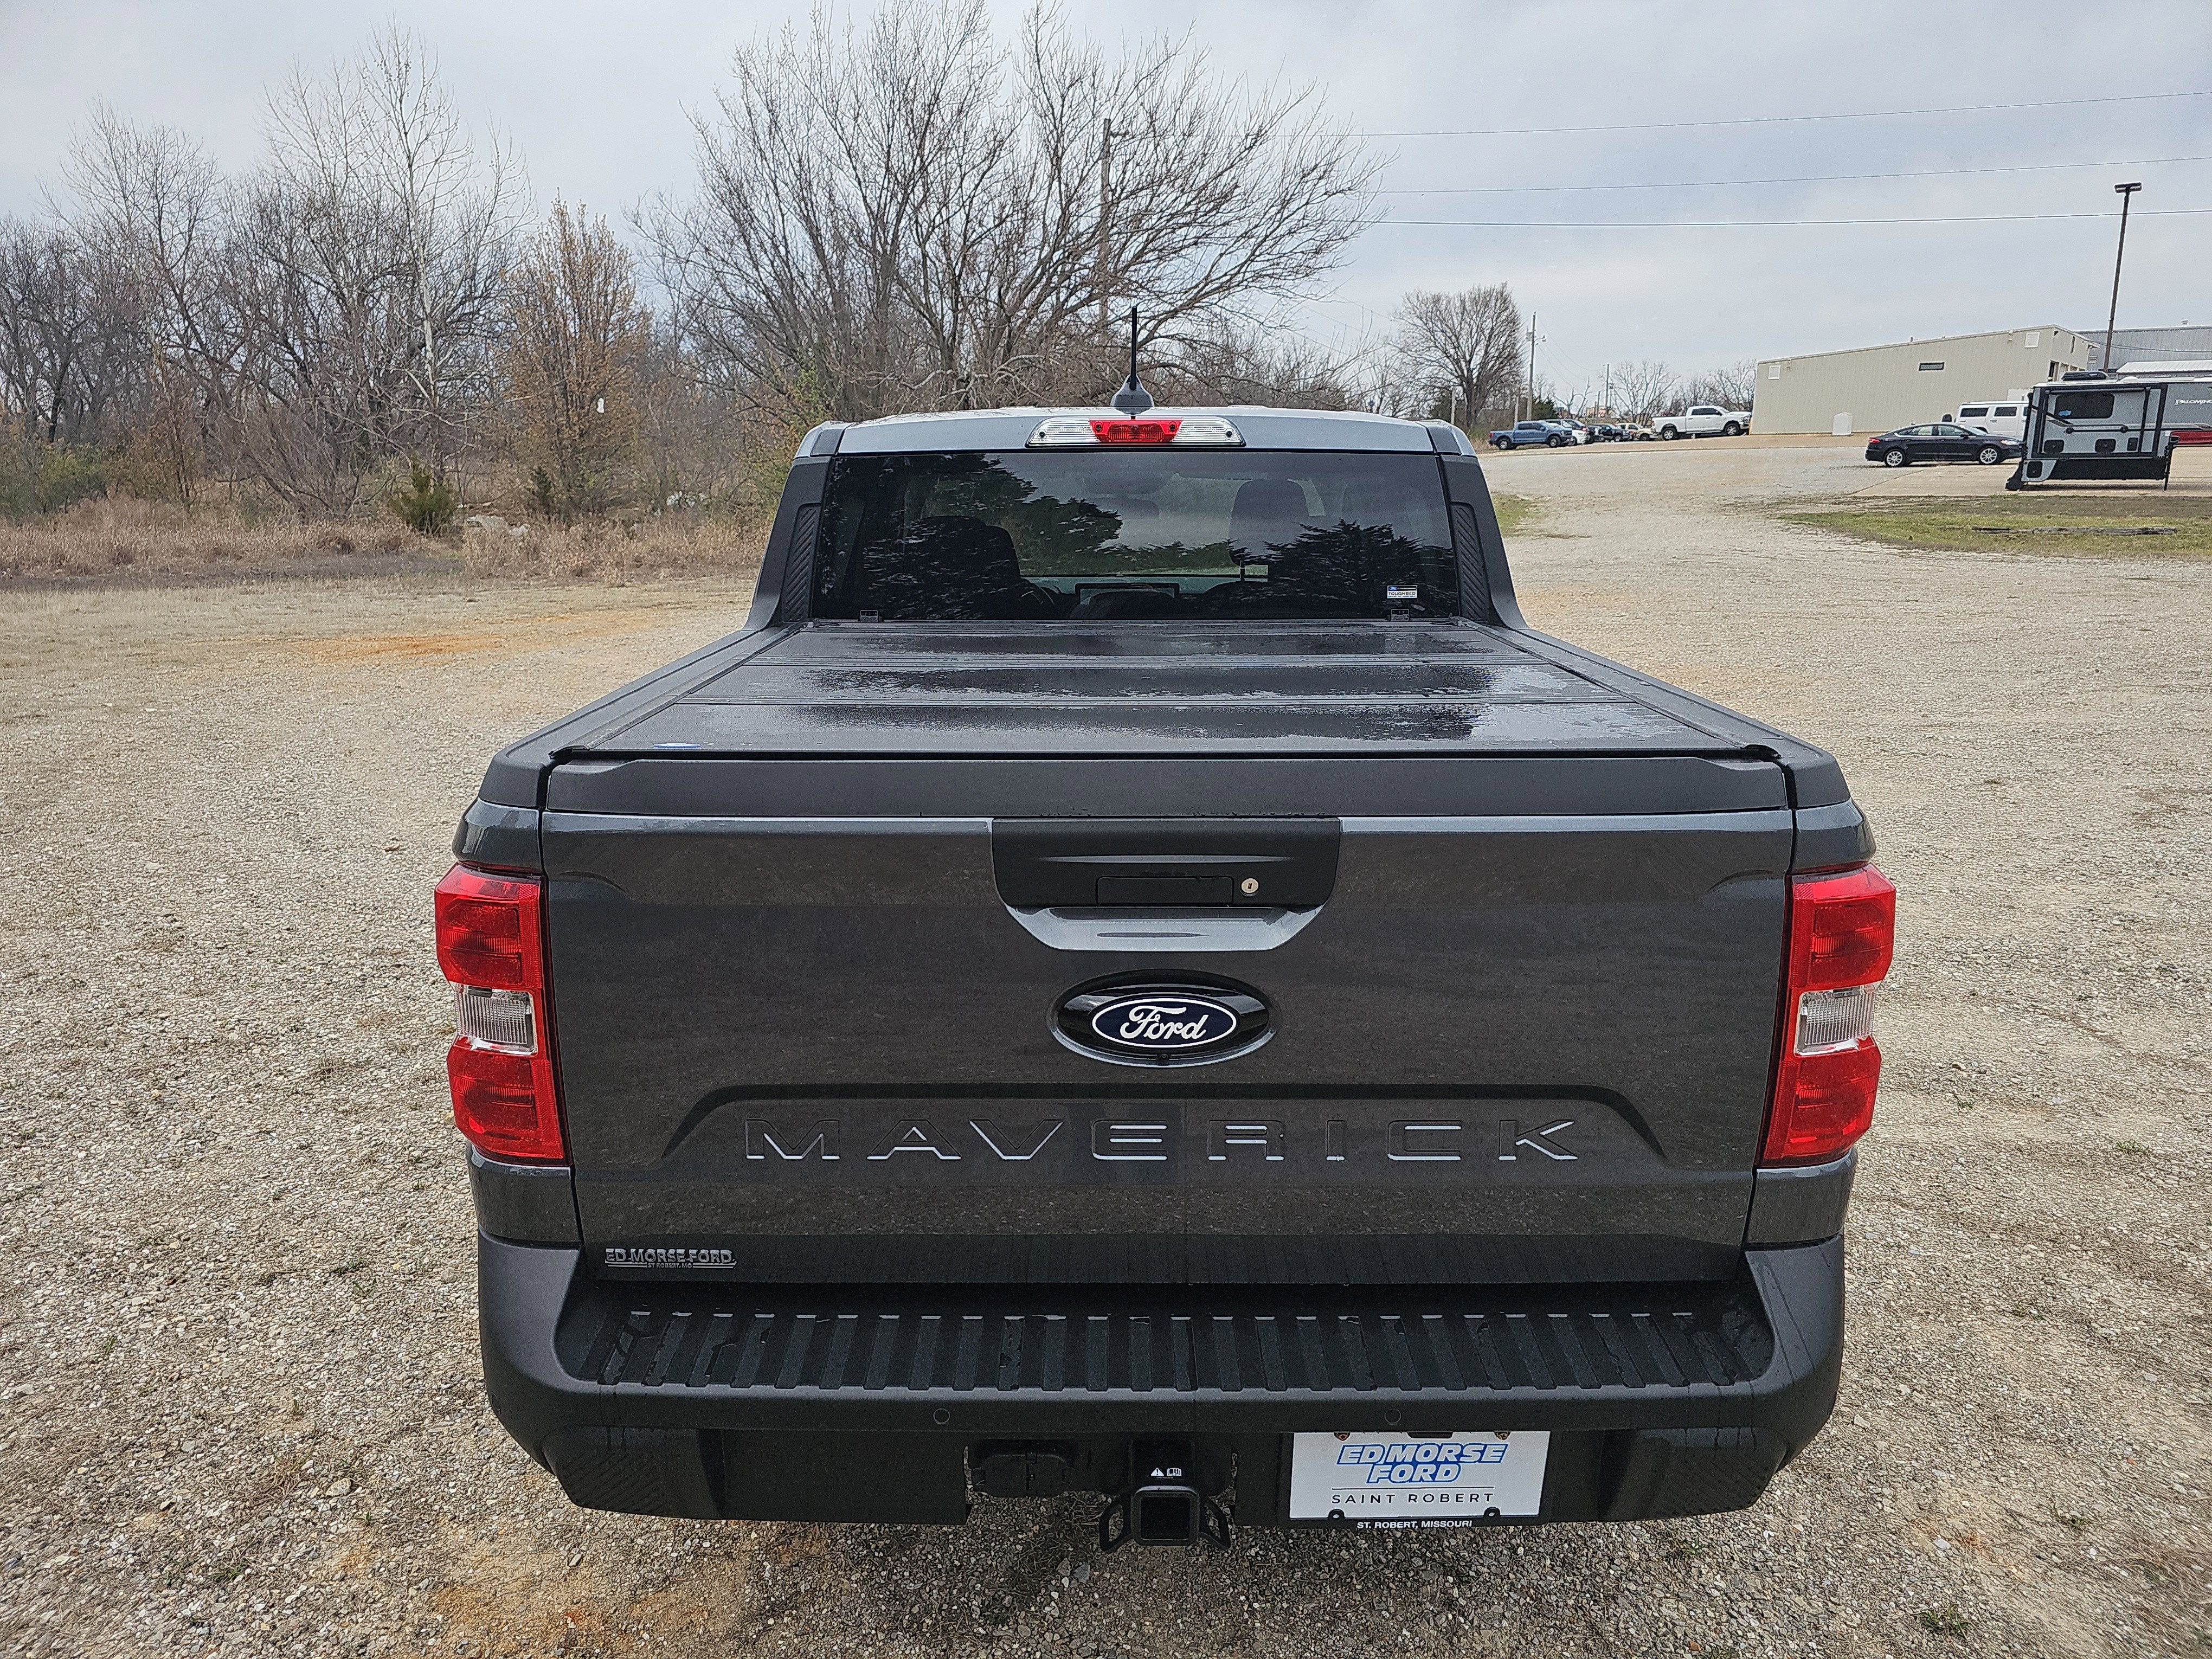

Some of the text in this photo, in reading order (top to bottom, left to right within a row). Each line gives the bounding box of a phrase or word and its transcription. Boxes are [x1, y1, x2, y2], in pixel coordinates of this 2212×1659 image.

[1120, 1005, 1208, 1039] Ford
[745, 1119, 1578, 1161] MAVERICK
[606, 1248, 732, 1263] ED MORSE FORD
[1336, 1443, 1509, 1464] ED MORSE
[1366, 1463, 1461, 1484] FORD
[1332, 1493, 1494, 1503] SAINT ROBERT
